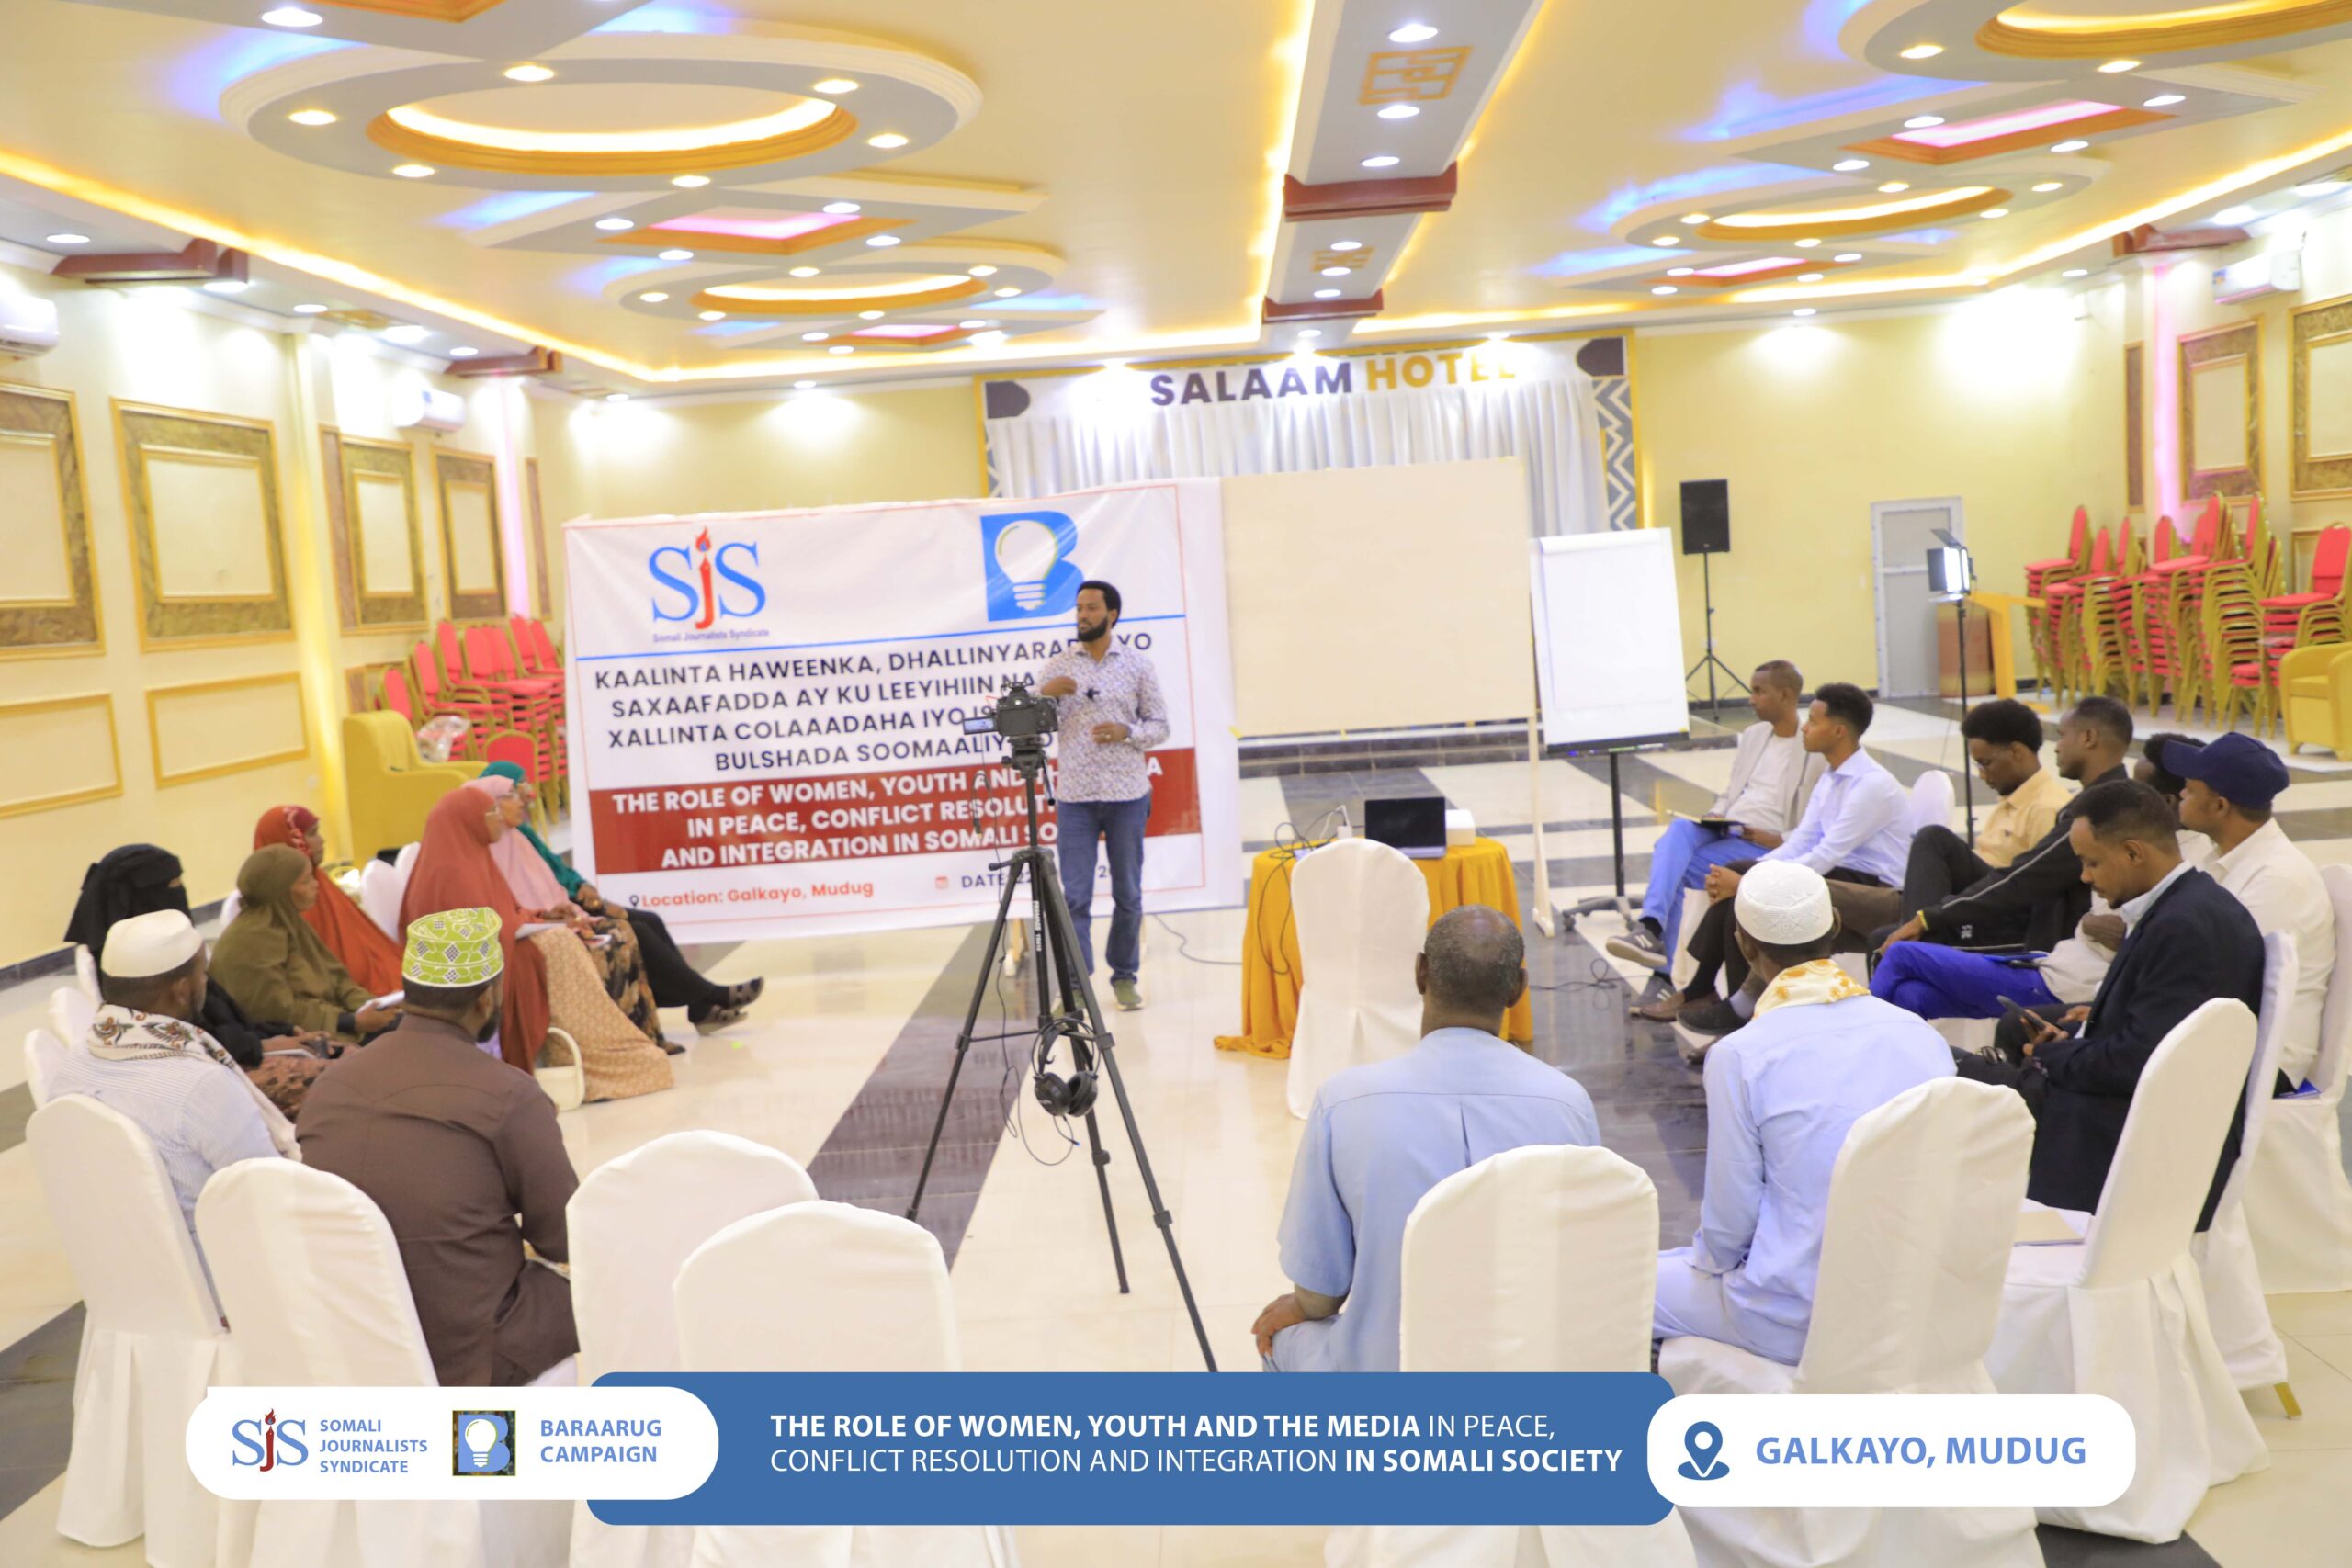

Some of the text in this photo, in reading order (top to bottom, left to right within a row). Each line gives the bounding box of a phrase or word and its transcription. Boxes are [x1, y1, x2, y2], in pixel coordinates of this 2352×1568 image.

[1150, 353, 1516, 406] SALAAM HOTEL
[729, 629, 769, 640] Syndicate
[595, 665, 720, 689] KAALINTA
[729, 656, 881, 682] HAWEENKA,
[612, 691, 787, 717] SAXAAFADDA
[797, 687, 829, 706] AY
[838, 685, 870, 704] KU
[879, 675, 993, 700] LEEYIHIIN
[609, 725, 728, 748] XALLINTA
[735, 711, 915, 740] COLAAADAHA
[923, 707, 965, 727] IYO
[716, 746, 849, 771] BULSHADA
[612, 793, 660, 814] THE
[665, 788, 725, 810] ROLE
[731, 785, 763, 807] OF
[769, 779, 875, 803] WOMEN,
[880, 772, 967, 796] YOUTH
[975, 767, 1026, 789] AND
[688, 818, 714, 838] IN
[719, 811, 806, 836] PEACE,
[811, 802, 937, 829] CONFLICT
[662, 848, 715, 869] AND
[720, 835, 888, 865] INTEGRATION
[893, 831, 919, 852] IN
[924, 826, 1018, 851] SOMALI
[642, 881, 874, 908] Location: Galkayo, Mudug
